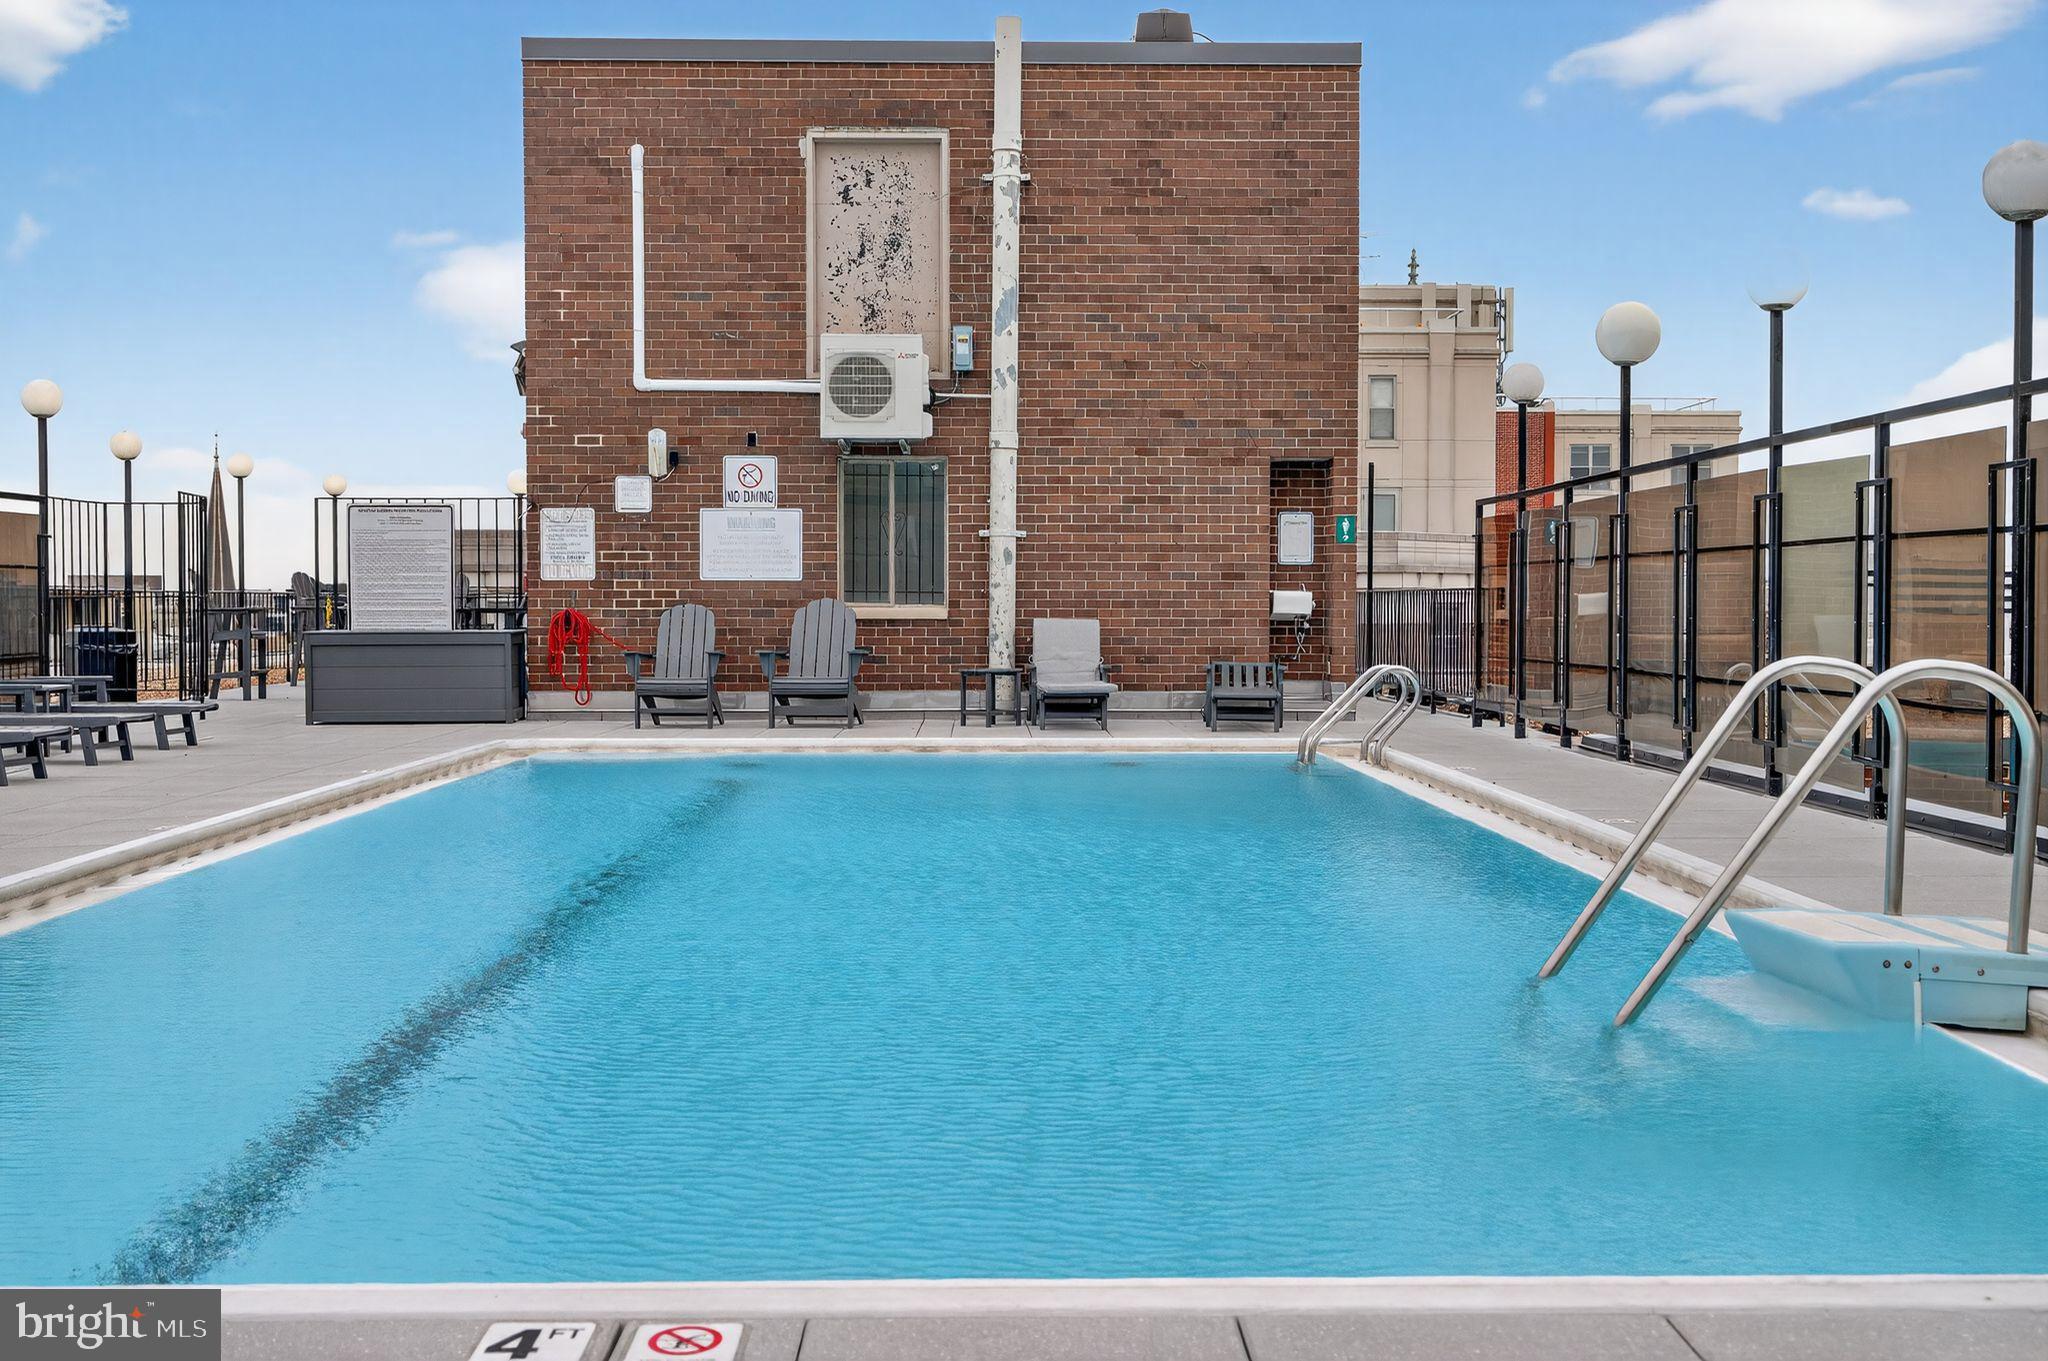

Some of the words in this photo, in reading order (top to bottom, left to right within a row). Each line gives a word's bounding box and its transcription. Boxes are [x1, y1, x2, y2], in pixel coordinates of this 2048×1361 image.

[727, 490, 740, 503] NO
[743, 490, 774, 503] DIVING
[484, 1329, 543, 1360] 4
[548, 1328, 585, 1339] FT
